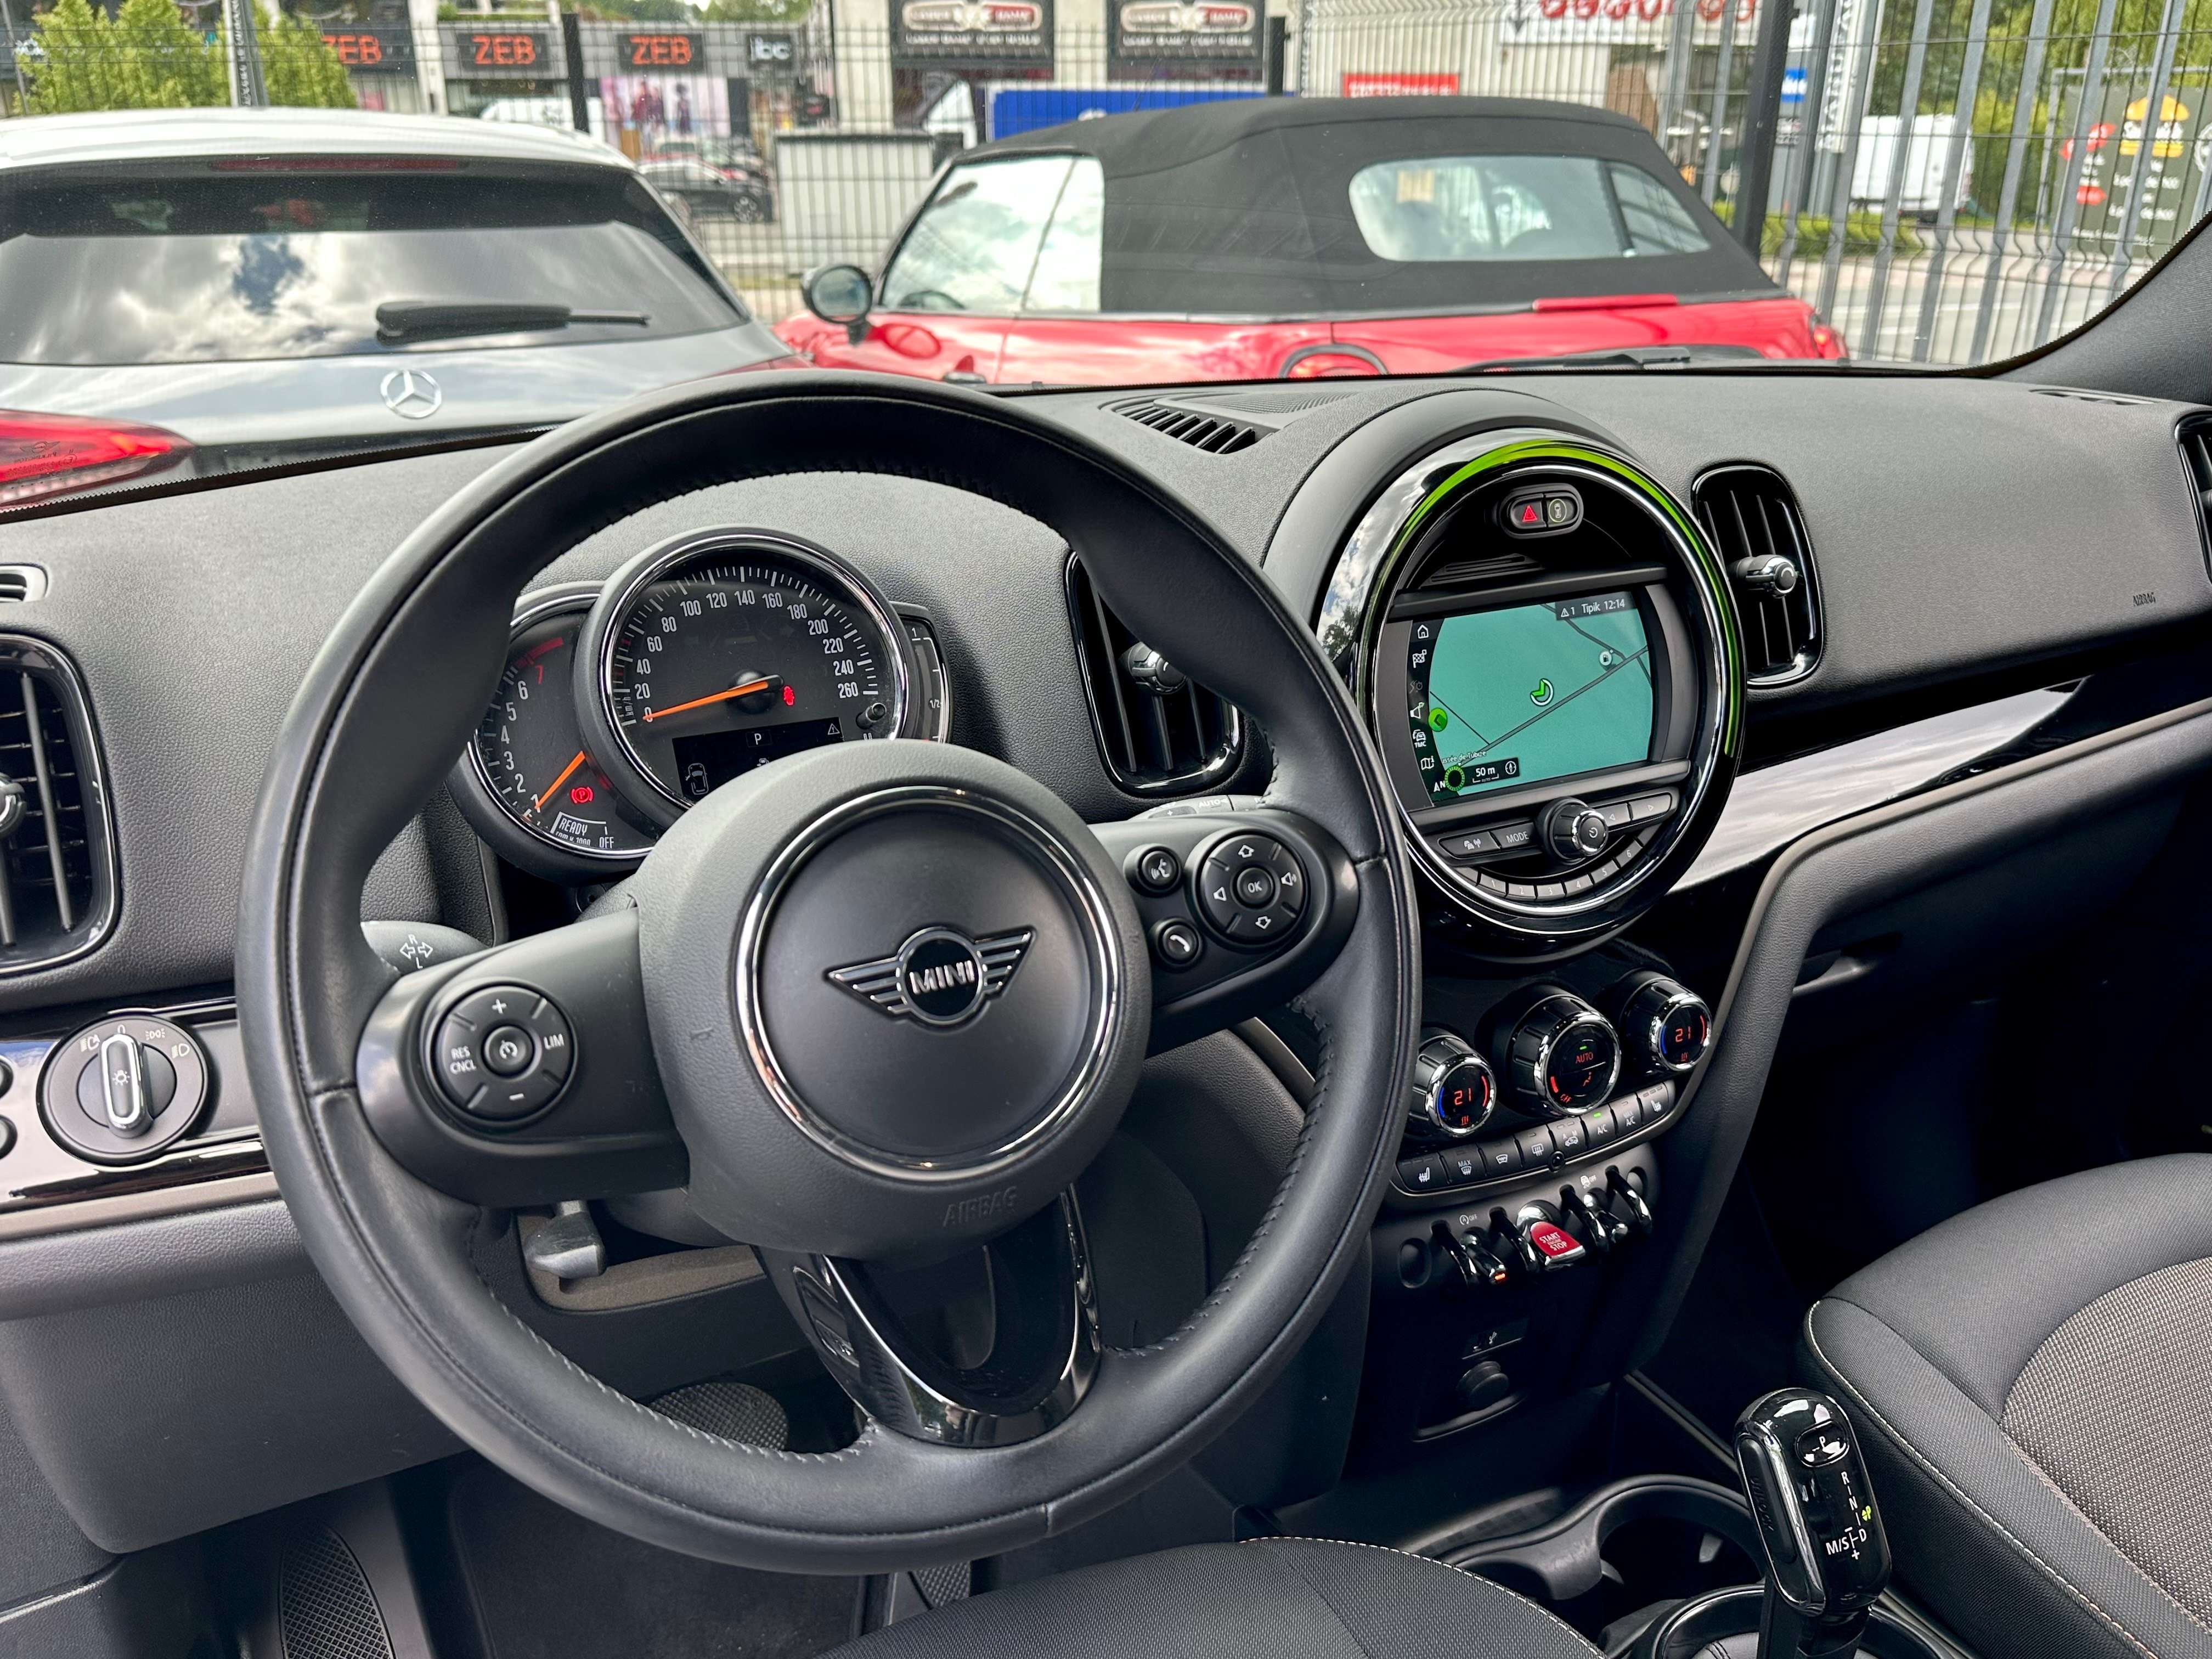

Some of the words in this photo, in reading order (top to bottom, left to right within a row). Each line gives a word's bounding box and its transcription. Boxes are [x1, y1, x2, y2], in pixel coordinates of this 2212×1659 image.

[471, 35, 536, 65] ZEB
[629, 35, 693, 65] ZEB
[706, 592, 727, 609] 120
[734, 589, 755, 606] 140
[761, 592, 783, 609] 160
[2132, 592, 2157, 607] AIRBAG
[680, 600, 702, 617] 100
[787, 603, 808, 620] 180
[1571, 607, 1576, 615] 1
[1581, 602, 1601, 615] Tipik
[1604, 599, 1625, 610] 12:14
[661, 616, 678, 633] 80
[808, 618, 829, 635] 200
[647, 636, 663, 652] 60
[823, 637, 844, 654] 220
[535, 664, 544, 685] 7
[636, 658, 651, 675] 40
[833, 659, 854, 676] 240
[517, 680, 528, 700] 6
[634, 682, 651, 700] 20
[837, 681, 859, 699] 260
[506, 702, 517, 721] 5
[622, 696, 634, 717] km/h
[500, 725, 510, 744] 4
[754, 733, 762, 745] P
[503, 751, 515, 770] 3
[1476, 769, 1486, 777] 50
[515, 773, 526, 793] 2
[1198, 799, 1221, 808] AUTO
[558, 817, 588, 836] READY
[599, 836, 614, 849] OFF
[1506, 831, 1530, 844] MODE
[1626, 850, 1632, 858] 6
[1601, 868, 1607, 877] 5
[1248, 880, 1262, 893] OK
[1491, 879, 1496, 888] 1
[1576, 880, 1581, 889] 4
[408, 934, 418, 944] R
[415, 957, 423, 969] L
[909, 960, 975, 995] MINI
[544, 1034, 565, 1050] LIM
[1675, 1026, 1691, 1042] 21
[450, 1046, 471, 1060] RES
[1576, 1052, 1594, 1064] AUTO
[450, 1059, 477, 1074] CNCL
[1453, 1087, 1474, 1106] 21
[1626, 1116, 1635, 1126] A/C
[1597, 1124, 1608, 1135] A/C
[1457, 1159, 1472, 1167] MAX
[1468, 1214, 1478, 1222] OFF
[1539, 1232, 1561, 1243] START
[1550, 1240, 1567, 1251] STOP
[1841, 1471, 1850, 1485] R
[1848, 1496, 1858, 1511] N
[1858, 1528, 1867, 1543] D
[1825, 1536, 1850, 1556] M/S
